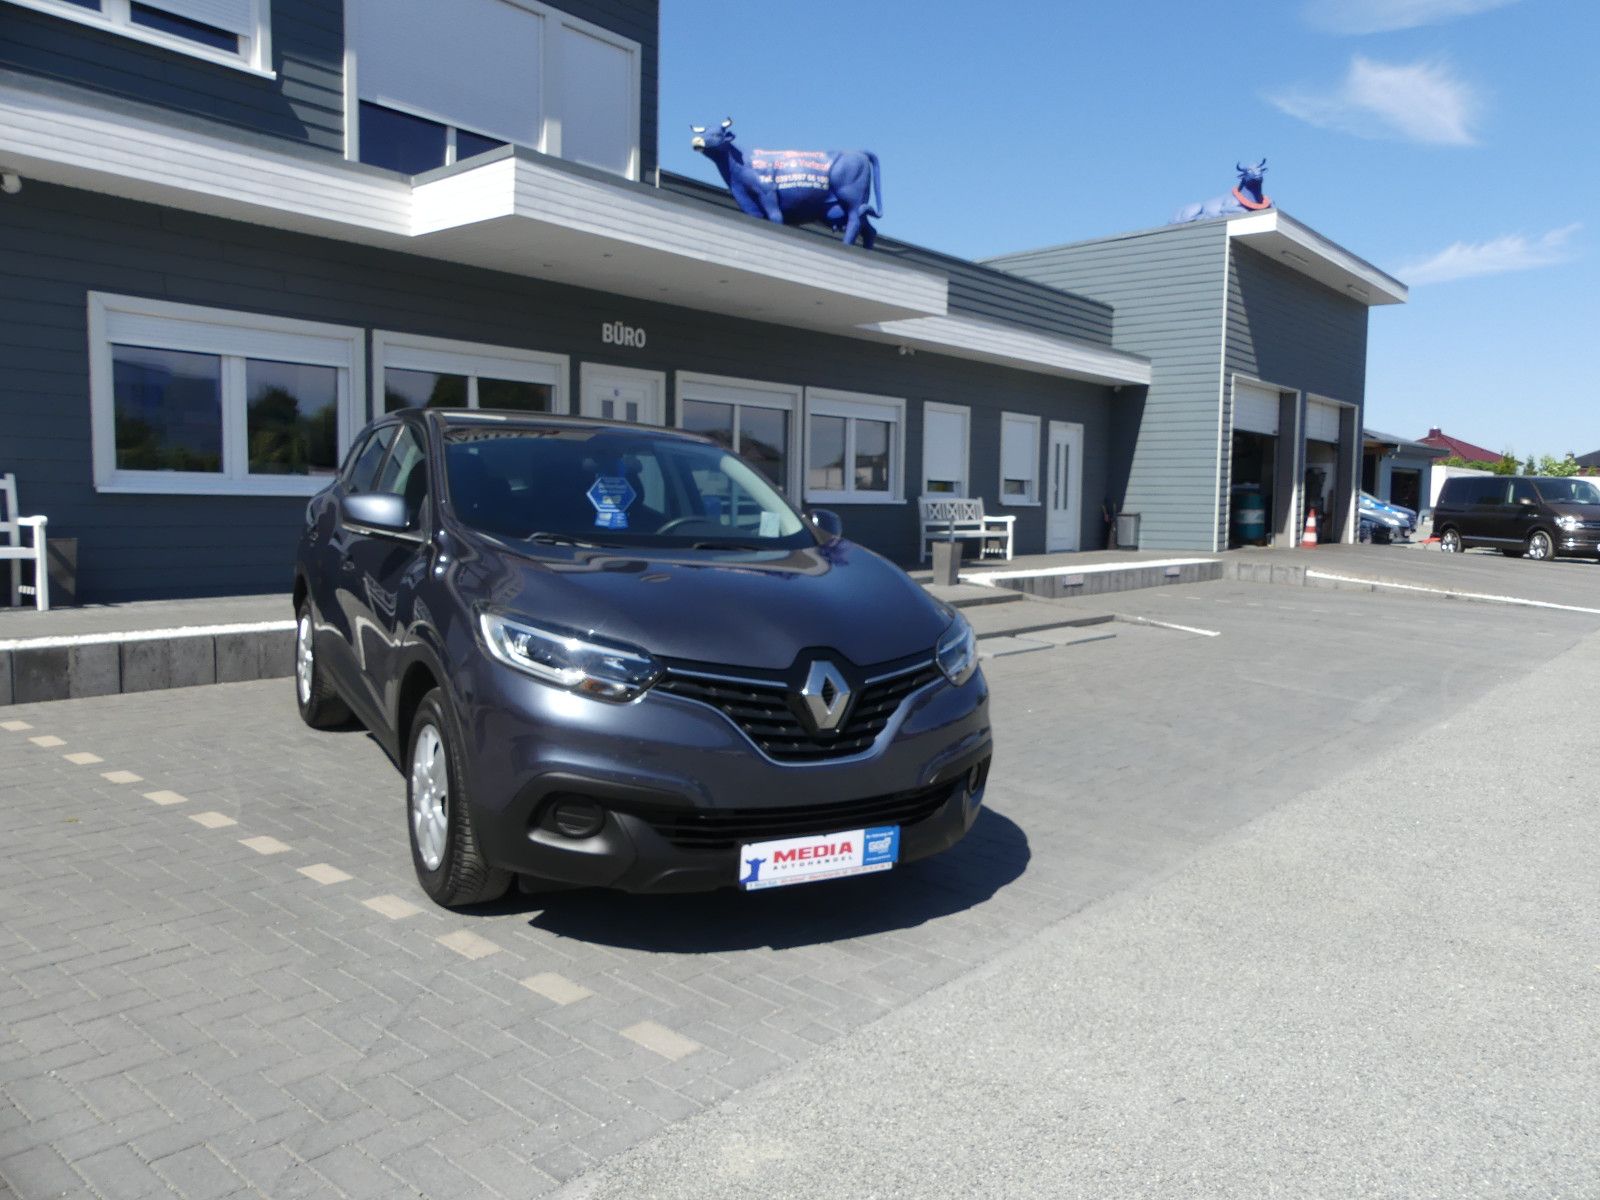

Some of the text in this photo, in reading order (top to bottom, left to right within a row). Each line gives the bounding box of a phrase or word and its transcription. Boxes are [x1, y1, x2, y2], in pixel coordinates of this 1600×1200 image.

[602, 321, 646, 348] BÜRO
[773, 841, 853, 864] MEDIA
[773, 856, 853, 870] AUTOHANDEL
